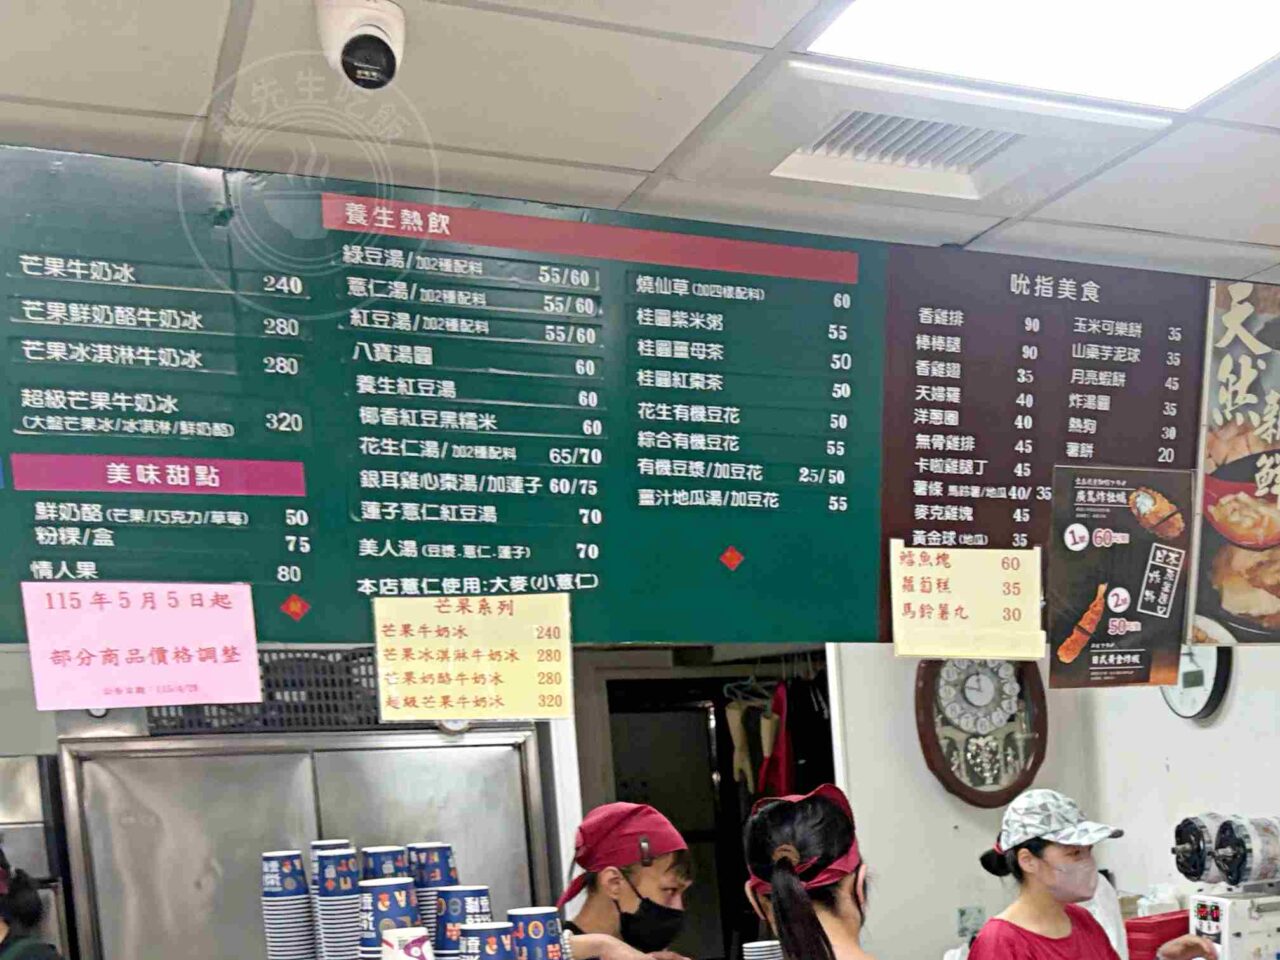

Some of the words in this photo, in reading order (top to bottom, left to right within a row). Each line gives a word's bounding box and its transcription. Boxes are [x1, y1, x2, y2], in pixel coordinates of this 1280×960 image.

[345, 202, 450, 235] 養生熱飲
[19, 255, 136, 282] 芒果牛奶冰
[262, 275, 303, 294] 240
[538, 265, 590, 286] 55/60
[1010, 273, 1101, 303] 吮指美食
[543, 295, 595, 314] 55/60
[833, 293, 851, 309] 60
[22, 300, 203, 330] 芒果鮮奶酪牛奶冰
[263, 318, 300, 336] 280
[636, 308, 724, 331] 桂圓紫米粥
[828, 324, 847, 340] 55
[918, 308, 964, 327] 香雞排
[1024, 317, 1040, 333] 90
[545, 325, 596, 344] 55/60
[1074, 317, 1142, 339] 玉米可樂餅
[1168, 327, 1182, 341] 35
[21, 340, 203, 369] 芒果冰淇淋牛奶冰
[262, 356, 299, 375] 280
[916, 335, 962, 353] 棒棒腿
[1022, 345, 1038, 360] 90
[1072, 343, 1141, 364] 山藥芋泥球
[1166, 352, 1181, 367] 35
[1213, 281, 1272, 426] 天然
[352, 341, 433, 366] 八寶湯圓
[575, 359, 595, 376] 60
[830, 353, 852, 370] 50
[915, 361, 961, 379] 香雞翅
[1017, 370, 1034, 384] 35
[1070, 368, 1126, 388] 月亮蝦餅
[1164, 377, 1180, 391] 45
[356, 375, 456, 398] 養生紅豆湯
[578, 390, 598, 408] 60
[832, 383, 851, 398] 50
[915, 385, 961, 403] 天婦羅
[1016, 393, 1034, 408] 40
[21, 388, 178, 414] 超級芒果牛奶冰
[265, 412, 303, 432] 320
[638, 402, 740, 424] 花生有機豆花
[830, 414, 847, 429] 50
[1069, 393, 1111, 412] 炸湯圓
[1163, 402, 1178, 417] 35
[358, 406, 498, 431] 椰香紅豆黑糯米
[582, 420, 602, 436] 60
[914, 409, 959, 427] 洋蔥圈
[1014, 415, 1033, 430] 40
[1068, 417, 1097, 435] 熱狗
[1161, 426, 1176, 440] 30
[637, 431, 740, 451] 綜合有機豆花
[826, 441, 845, 456] 55
[915, 434, 975, 452] 無骨雞排
[1015, 440, 1033, 454] 45
[1066, 442, 1095, 459] 薯餅
[1158, 448, 1175, 463] 20
[549, 448, 602, 465] 65/70
[106, 463, 221, 487] 美味甜點
[799, 467, 845, 484] 25/50
[1013, 463, 1031, 477] 45
[549, 478, 598, 495] 60/75
[913, 480, 944, 496] 薯條
[361, 501, 497, 523] 蓮子薏仁紅豆湯
[578, 509, 602, 525] 70
[828, 496, 847, 511] 55
[914, 504, 973, 521] 麥克雞塊
[1013, 508, 1030, 522] 45
[285, 509, 309, 526] 50
[35, 527, 115, 547] 粉粿/盒
[284, 536, 311, 553] 75
[1012, 533, 1028, 547] 35
[576, 543, 599, 559] 70
[30, 561, 99, 580] 情人果
[276, 566, 302, 582] 80
[1001, 557, 1021, 571] 60
[901, 576, 951, 594] 蘿蔔糕
[1002, 582, 1021, 596] 35
[435, 599, 514, 616] 芒果系列
[901, 603, 969, 621] 馬鈴薯丸
[1002, 608, 1021, 622] 30
[381, 624, 468, 638] 芒果牛奶冰
[536, 626, 561, 640] 240
[49, 646, 242, 668] 部分商品價格調整
[383, 648, 520, 662] 芒果冰淇淋牛奶冰
[537, 649, 562, 662] 280
[384, 672, 504, 685] 芒果奶酪牛奶冰
[537, 672, 562, 685] 280
[386, 695, 505, 709] 超級芒果牛奶冰
[538, 694, 562, 708] 320
